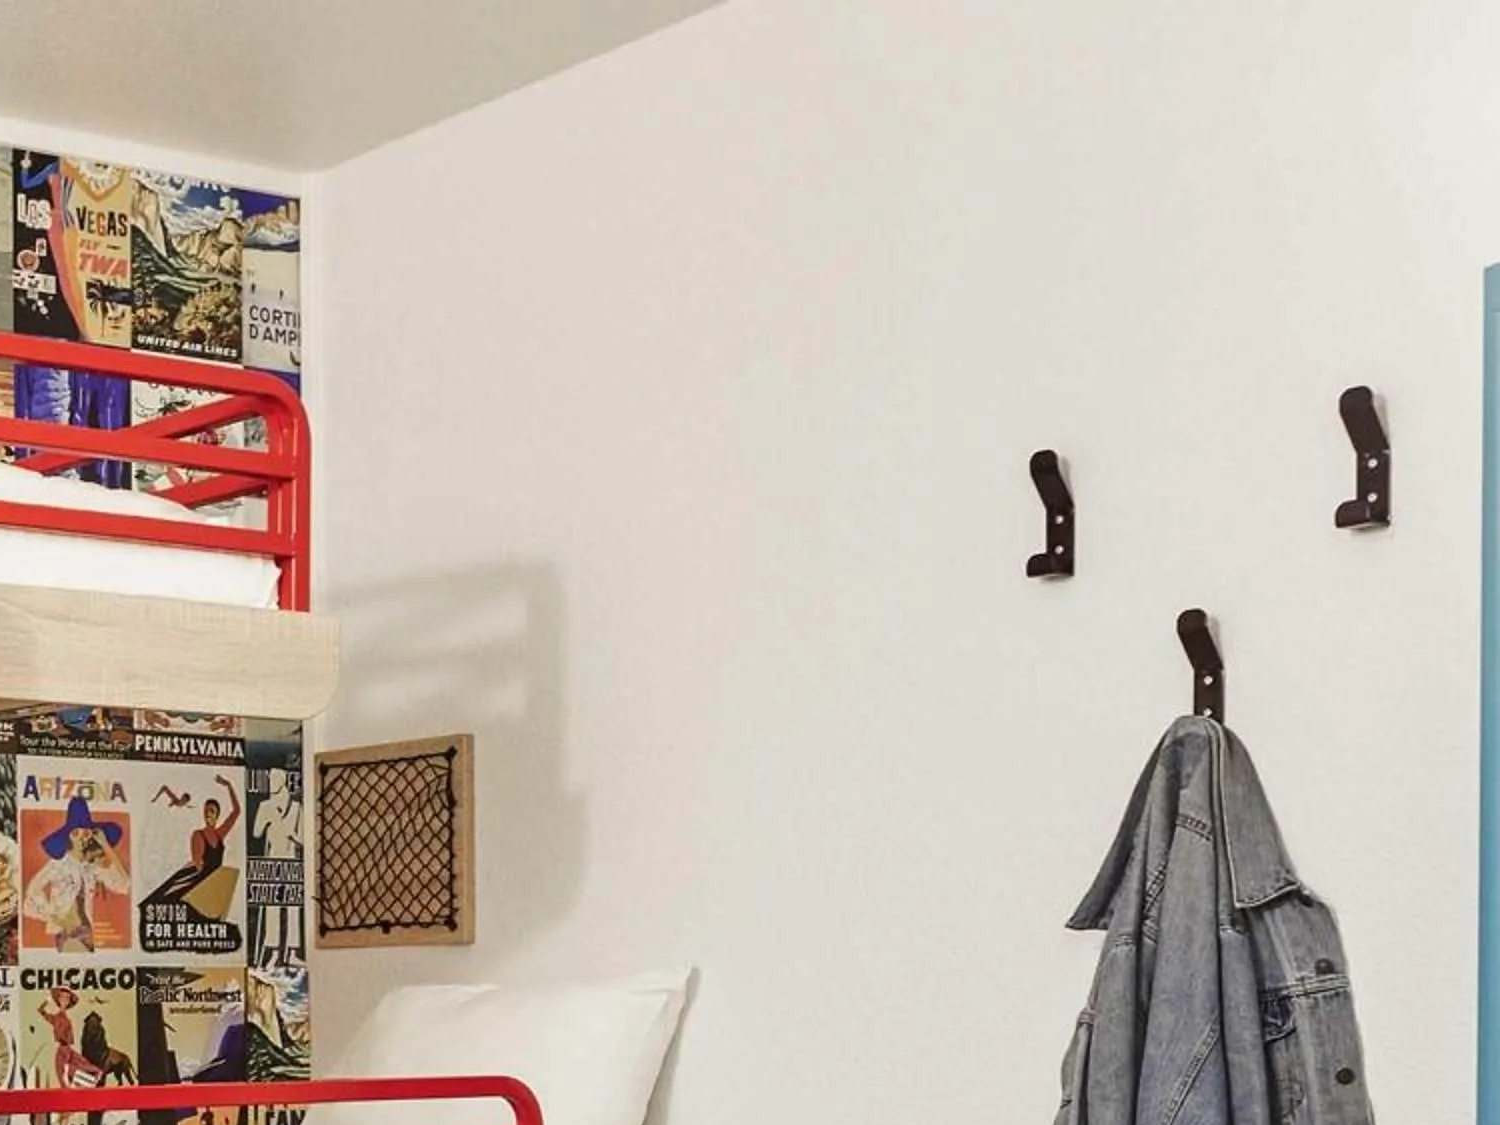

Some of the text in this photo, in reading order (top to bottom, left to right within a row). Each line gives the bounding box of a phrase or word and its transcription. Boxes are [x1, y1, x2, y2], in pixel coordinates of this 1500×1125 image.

[17, 193, 51, 229] LOS
[76, 206, 128, 236] VEGAS
[80, 253, 130, 278] TWA
[250, 305, 300, 328] CORTI
[137, 335, 238, 357] UNITED AIR LINES
[135, 735, 244, 758] PENNSYLVANIA
[23, 775, 128, 803] ARIZONA
[146, 905, 187, 922] SWIM
[146, 923, 227, 938] FOR HEALTH
[20, 967, 136, 991] CHICAGO
[183, 988, 241, 1003] Northwest
